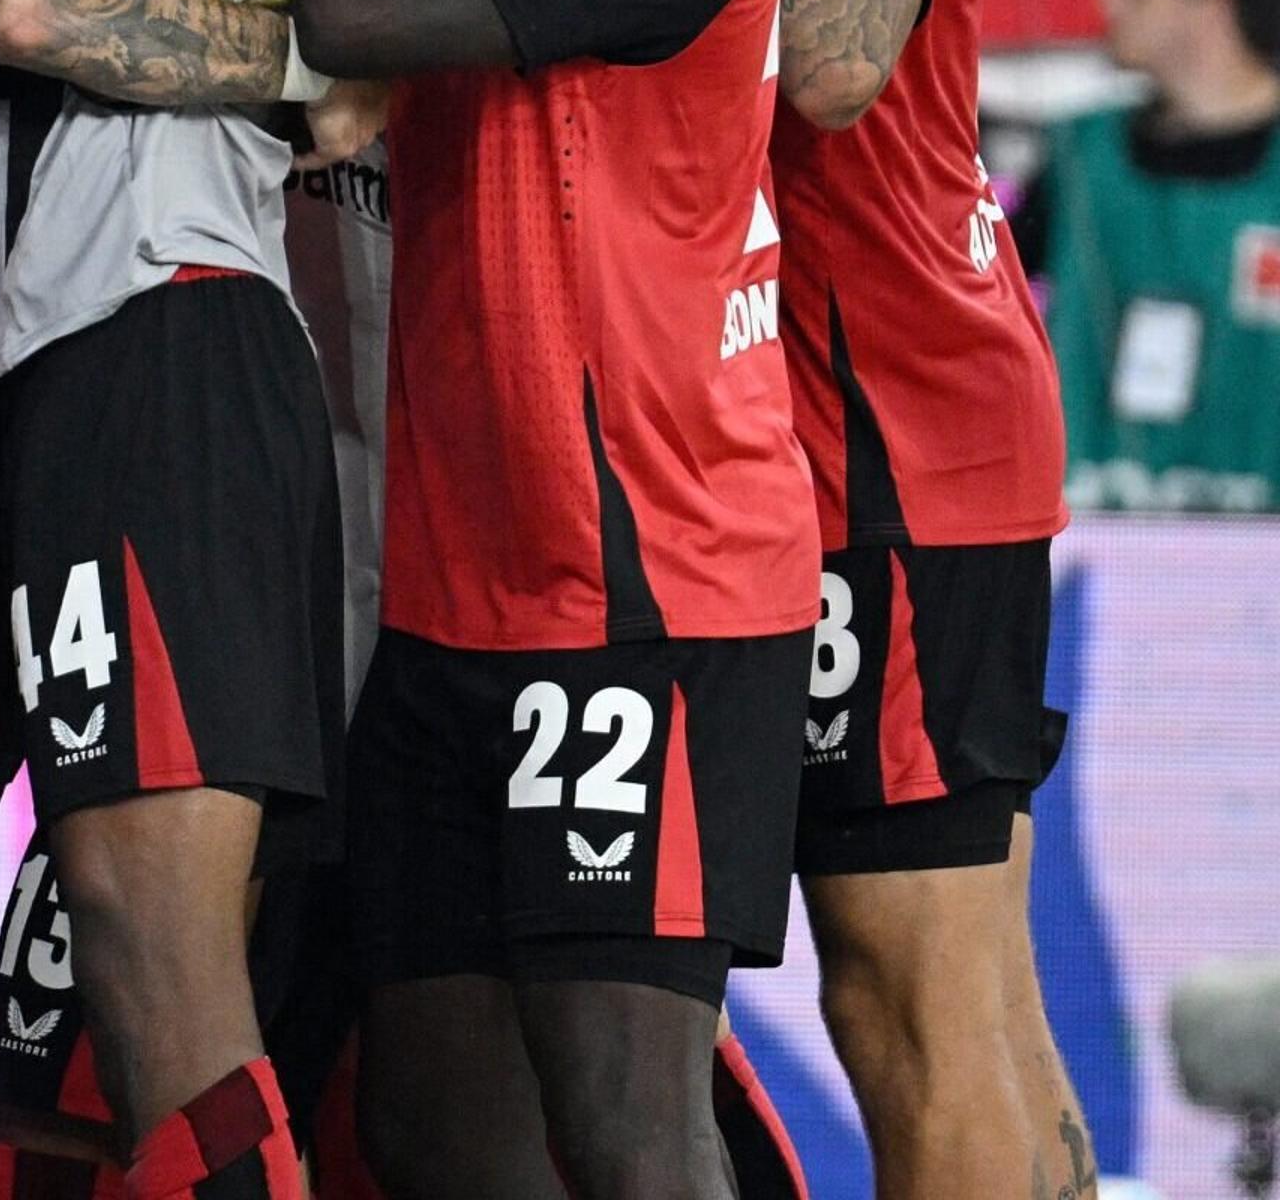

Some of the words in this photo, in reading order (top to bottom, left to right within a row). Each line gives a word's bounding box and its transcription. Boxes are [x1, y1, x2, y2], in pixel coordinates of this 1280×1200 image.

[10, 559, 118, 714] 44
[56, 745, 108, 767] CASTORE
[508, 680, 654, 814] 22
[567, 870, 632, 882] CASTORE
